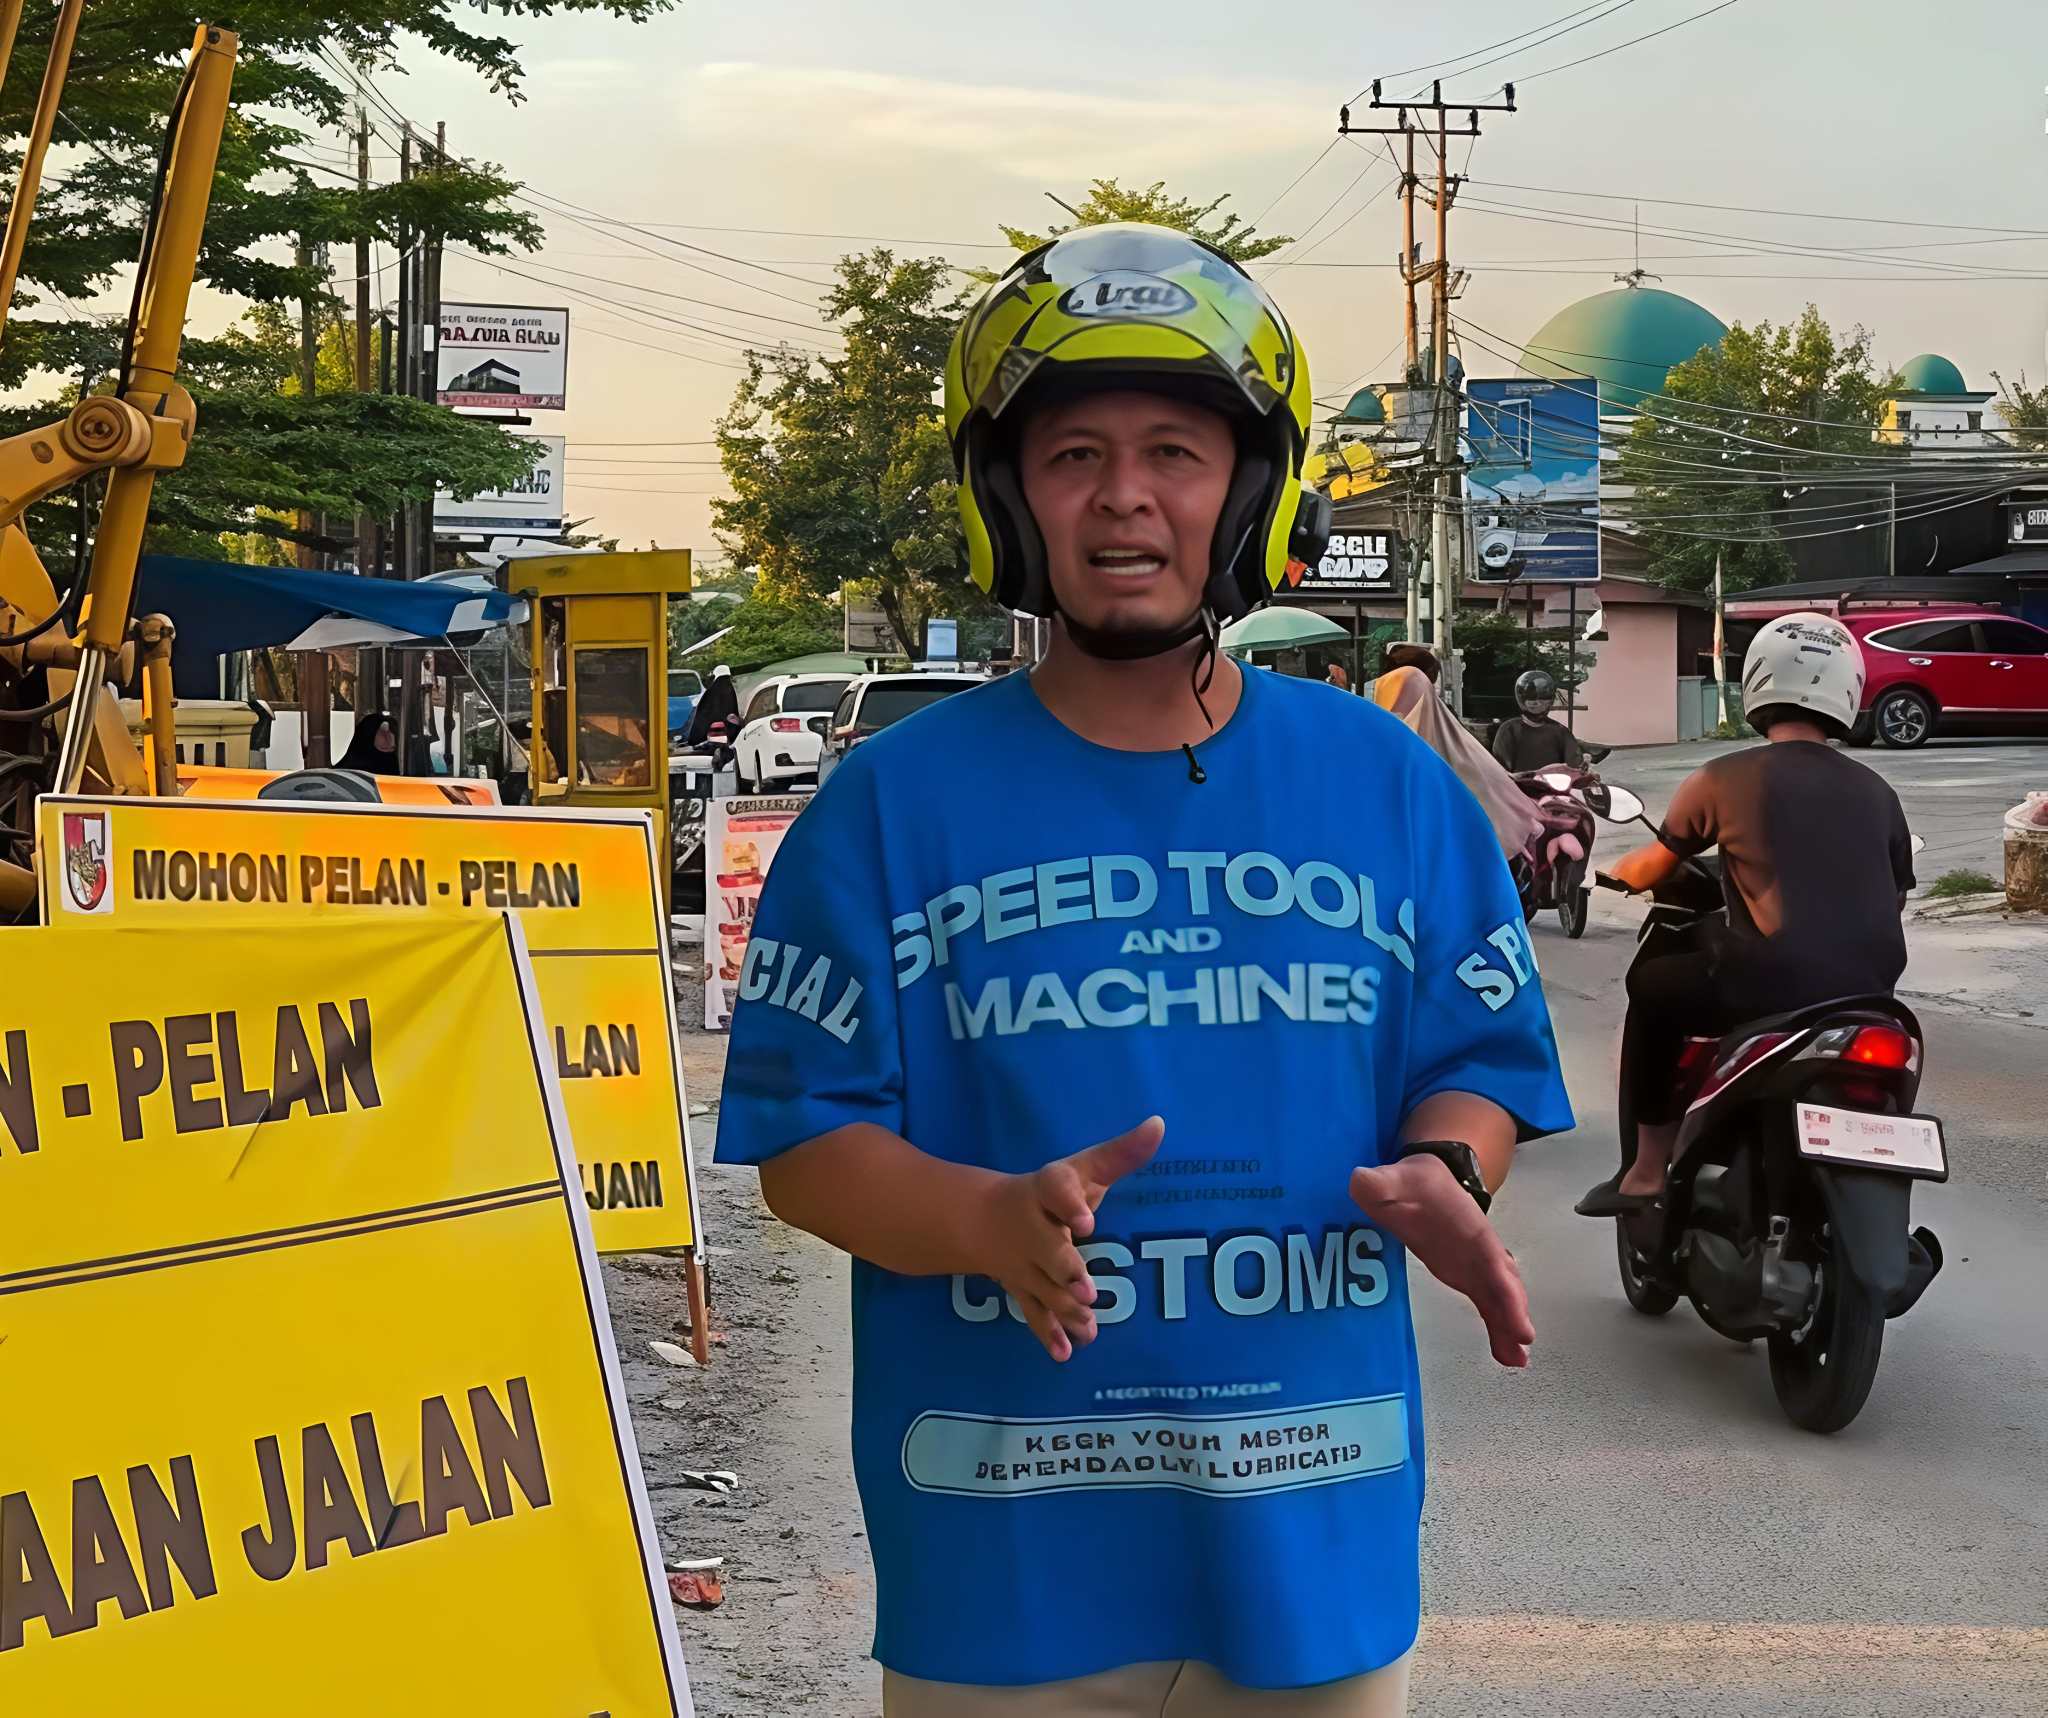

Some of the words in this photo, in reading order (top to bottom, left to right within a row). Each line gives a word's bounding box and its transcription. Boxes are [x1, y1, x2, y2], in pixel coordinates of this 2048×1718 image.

[133, 849, 287, 903] MOHON
[301, 856, 427, 906] PELAN
[460, 860, 580, 908] PELAN
[891, 854, 1158, 990] SPEED
[1119, 926, 1223, 955] AND
[739, 936, 864, 1045] CIAL
[943, 962, 1381, 1041] MACHINES
[109, 997, 382, 1143] PELAN
[555, 1024, 641, 1079] LAN
[951, 1228, 1389, 1325] CSTOMS
[0, 1454, 219, 1653] AAN
[240, 1376, 552, 1582] JALAN
